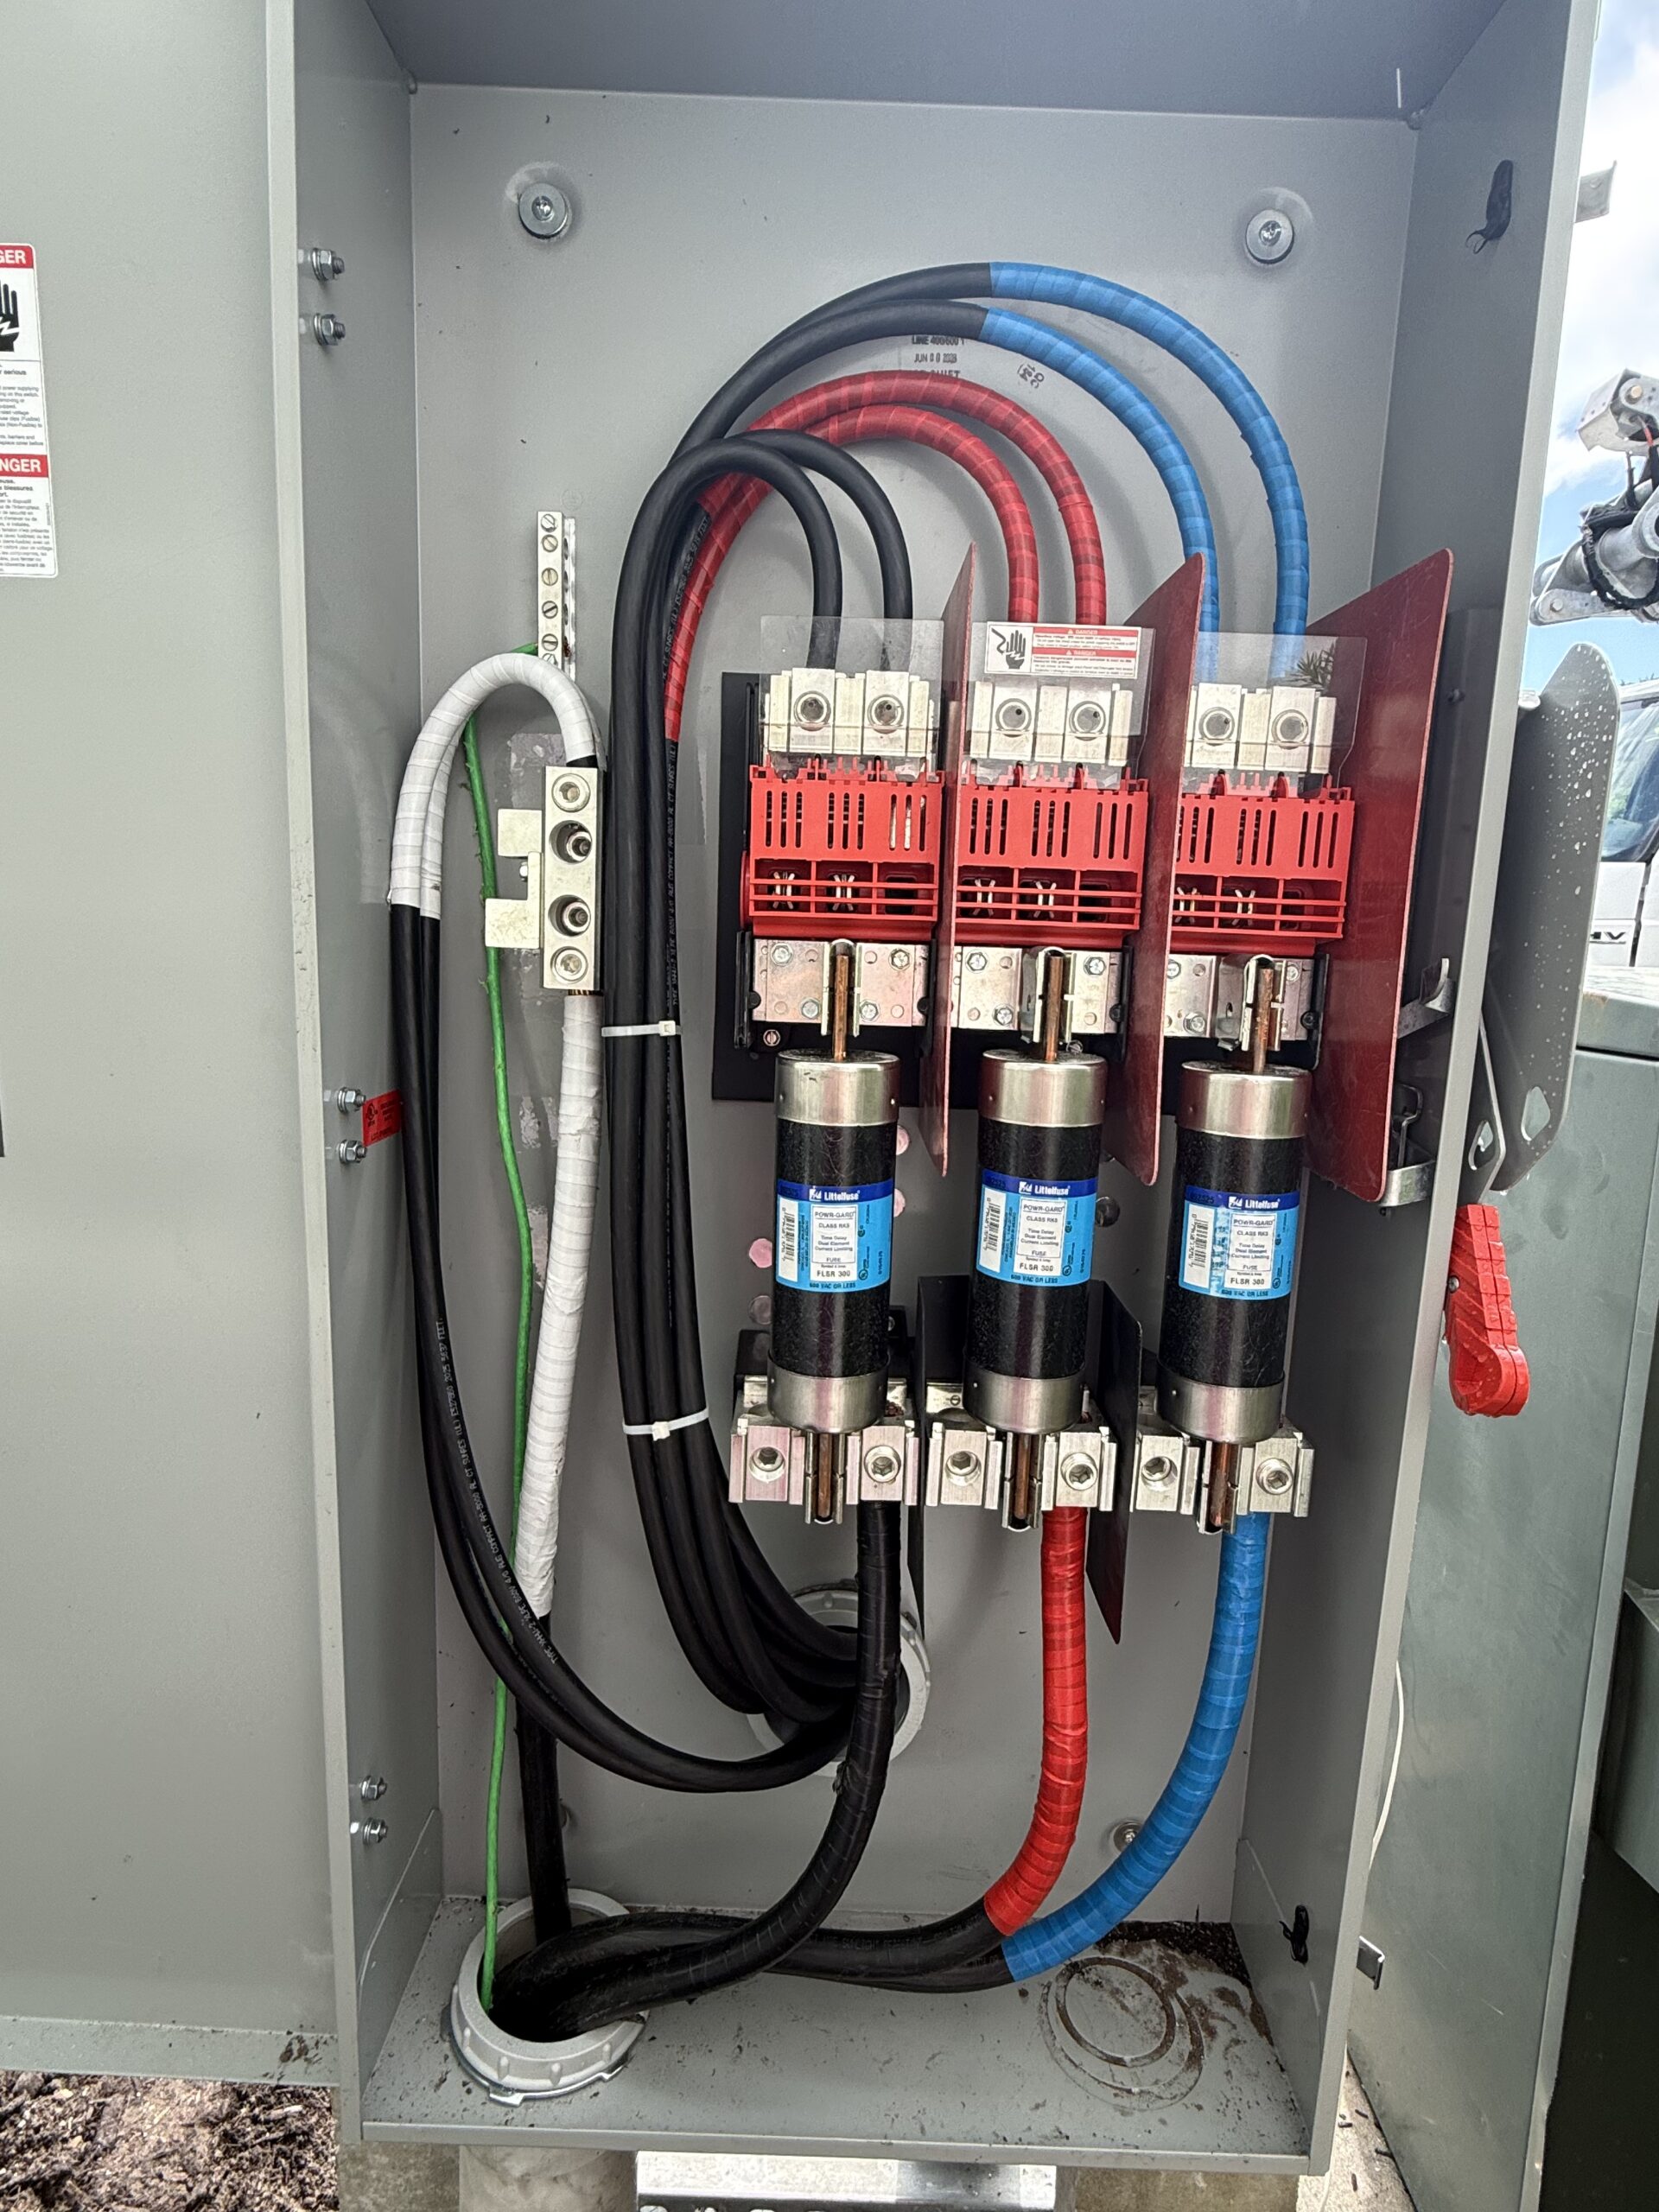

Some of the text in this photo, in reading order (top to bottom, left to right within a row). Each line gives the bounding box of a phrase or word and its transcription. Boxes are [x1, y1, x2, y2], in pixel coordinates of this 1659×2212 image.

[1035, 1185, 1068, 1195] Littelfuse
[824, 1192, 859, 1201] Littelfuse
[465, 1468, 473, 1477] CT
